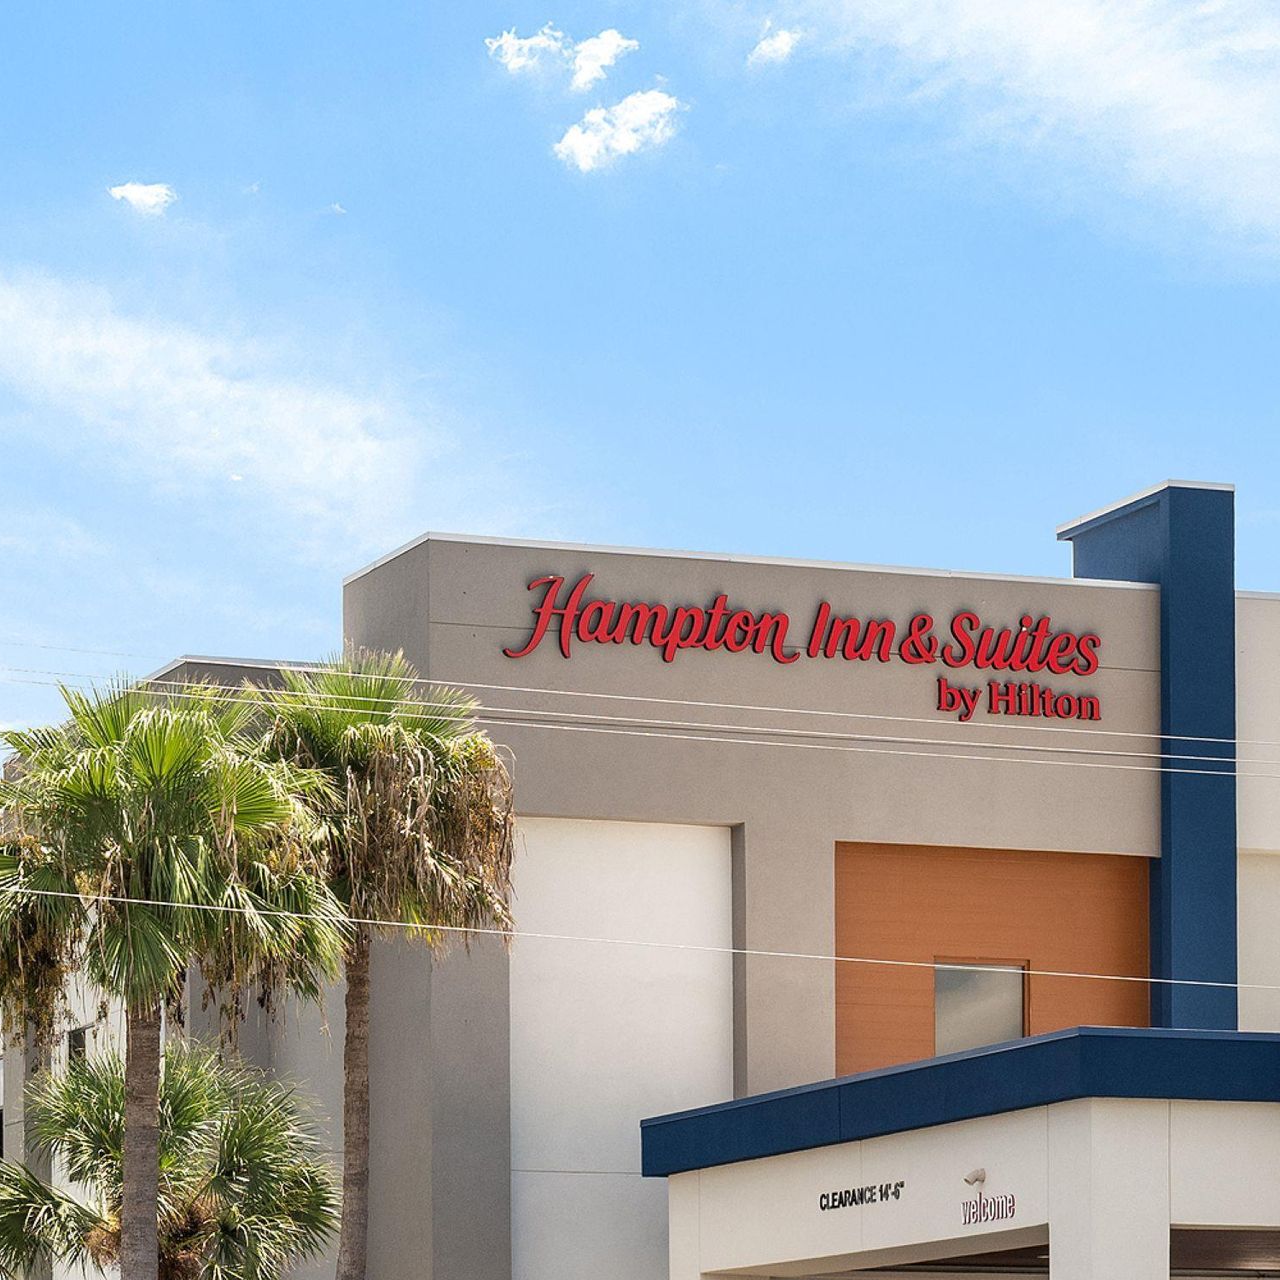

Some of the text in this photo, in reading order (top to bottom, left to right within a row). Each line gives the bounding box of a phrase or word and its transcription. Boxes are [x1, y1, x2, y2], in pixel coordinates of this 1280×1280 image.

[503, 571, 1102, 676] Hampton Inn & Suites
[937, 677, 1101, 721] by Hilton
[819, 1180, 905, 1211] CLEARANCE 14'-6"
[960, 1192, 1016, 1226] welcome
